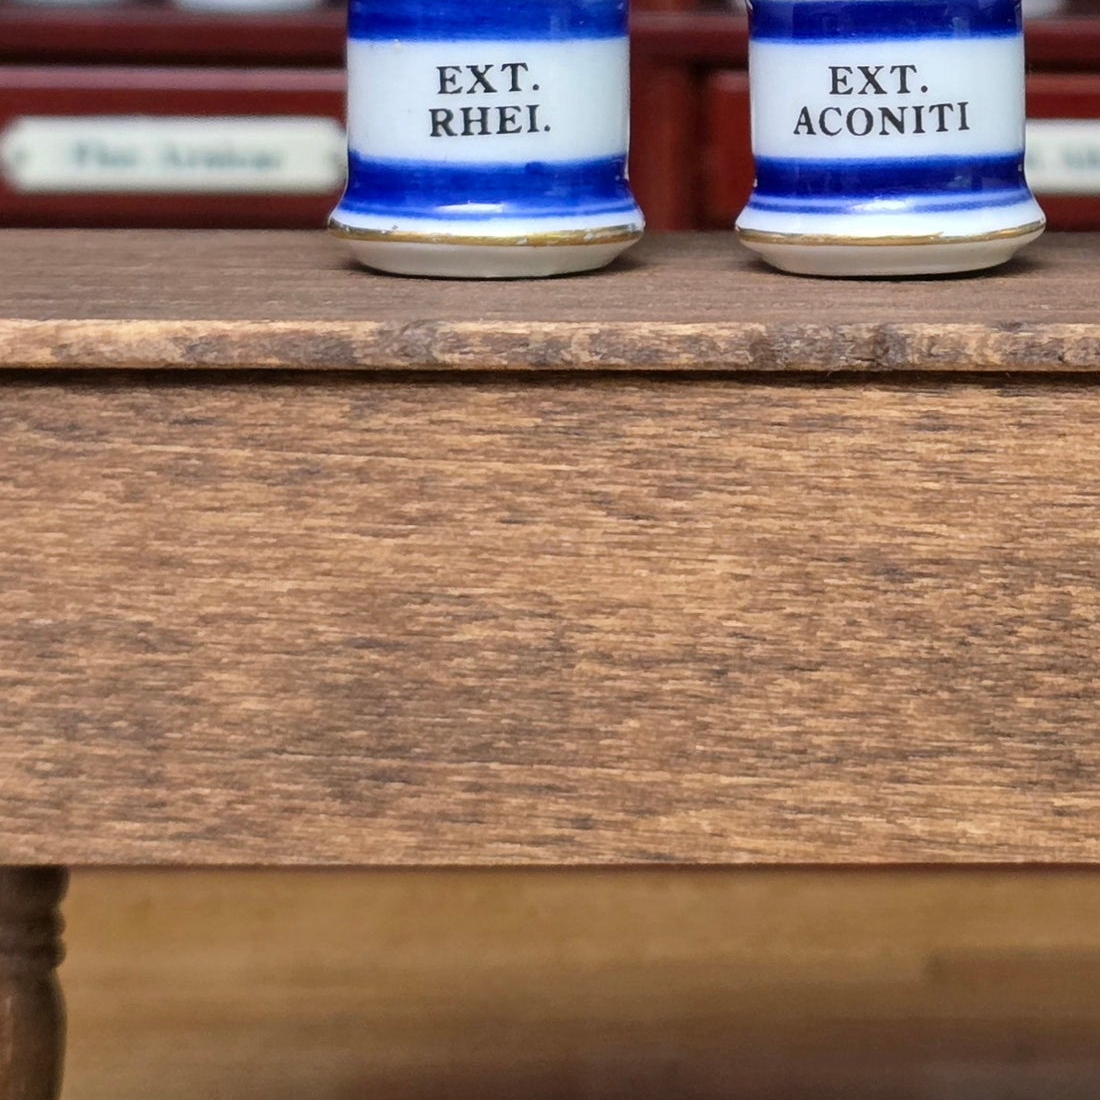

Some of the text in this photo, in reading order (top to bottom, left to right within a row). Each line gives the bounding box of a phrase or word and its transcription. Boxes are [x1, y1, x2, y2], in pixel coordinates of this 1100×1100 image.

[437, 63, 540, 95] EXT.
[828, 64, 929, 95] EXT.
[428, 105, 551, 138] RHEI.
[794, 102, 970, 137] ACONITI
